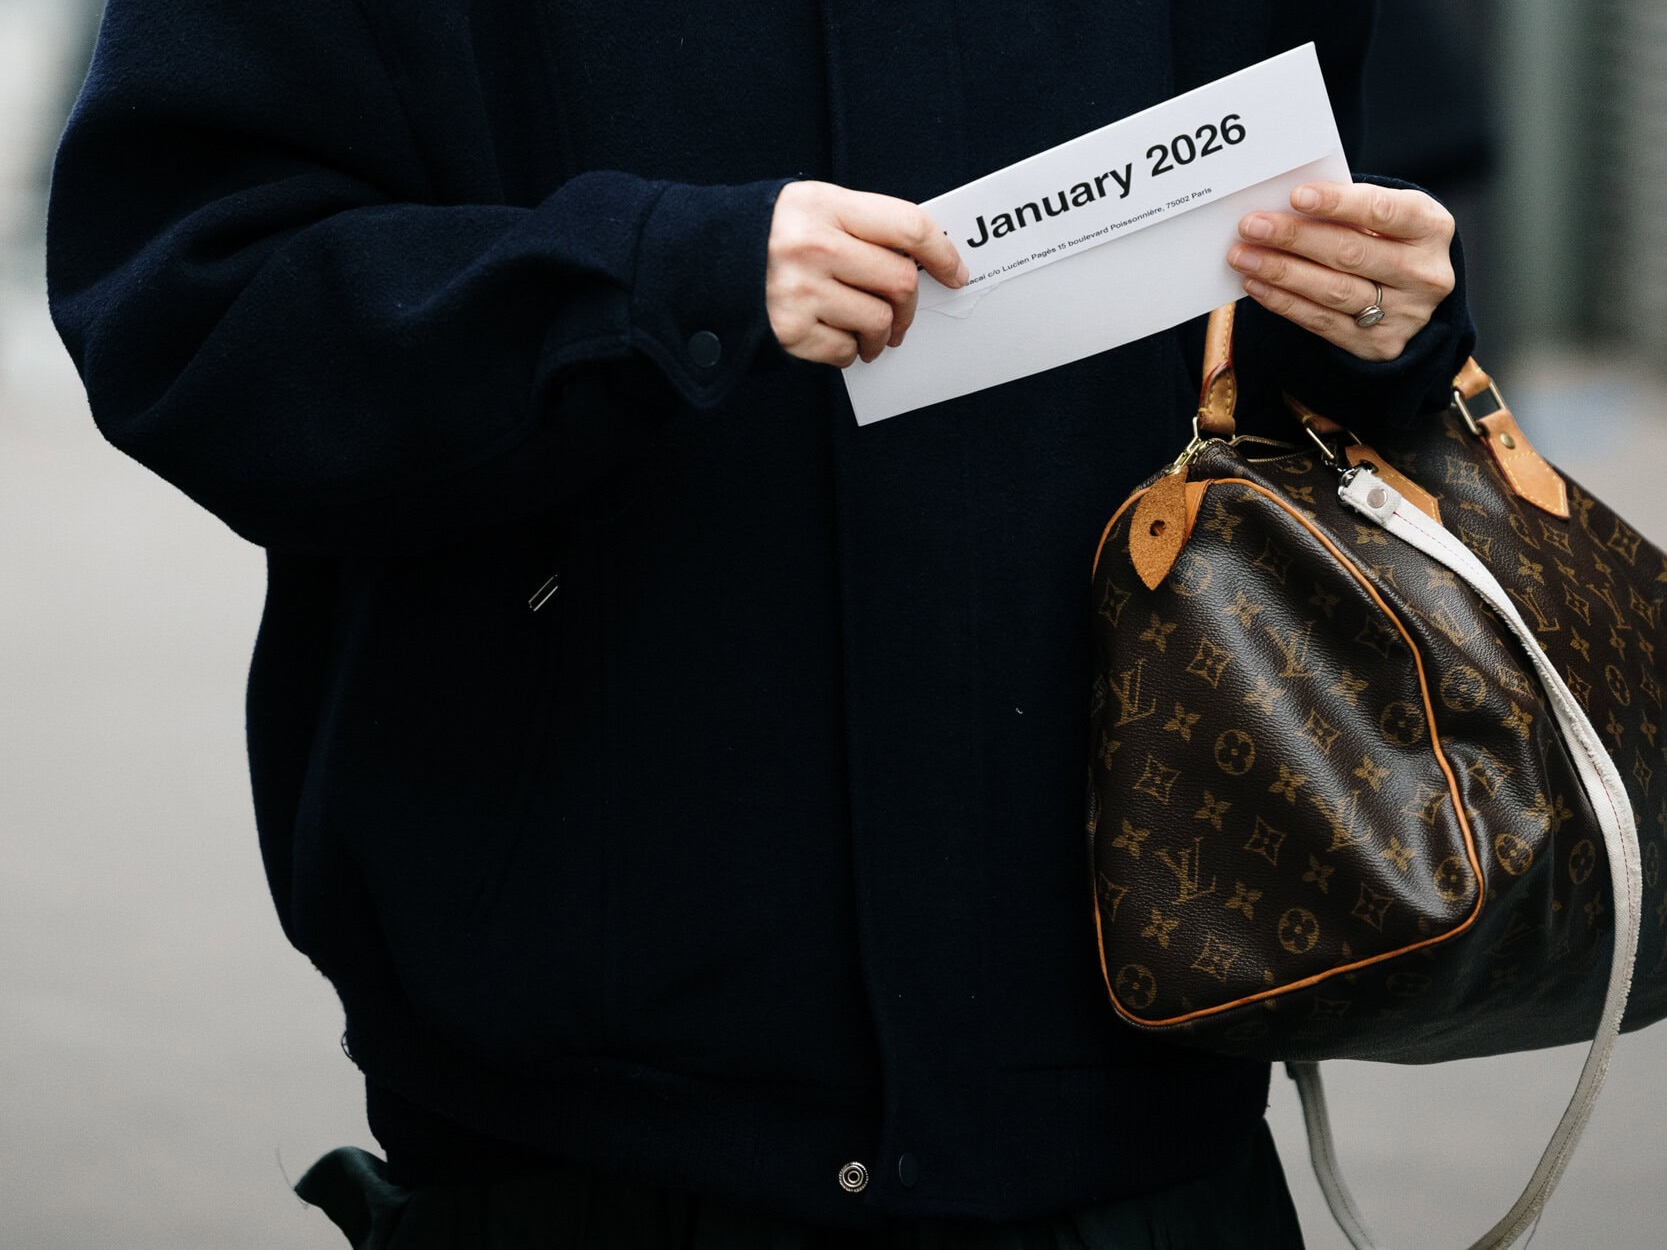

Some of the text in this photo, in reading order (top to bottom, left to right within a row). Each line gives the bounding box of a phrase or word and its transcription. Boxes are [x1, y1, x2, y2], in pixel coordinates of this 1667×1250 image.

[967, 113, 1246, 248] January 2026
[988, 267, 1001, 278] c/o
[1002, 257, 1030, 272] Lucien
[1031, 247, 1056, 261] Pagès
[1058, 242, 1067, 250] 15
[1068, 227, 1109, 247] boulevard
[1111, 206, 1165, 231] Poissonnière,
[1166, 195, 1190, 213] 75002
[1191, 187, 1212, 199] Paris
